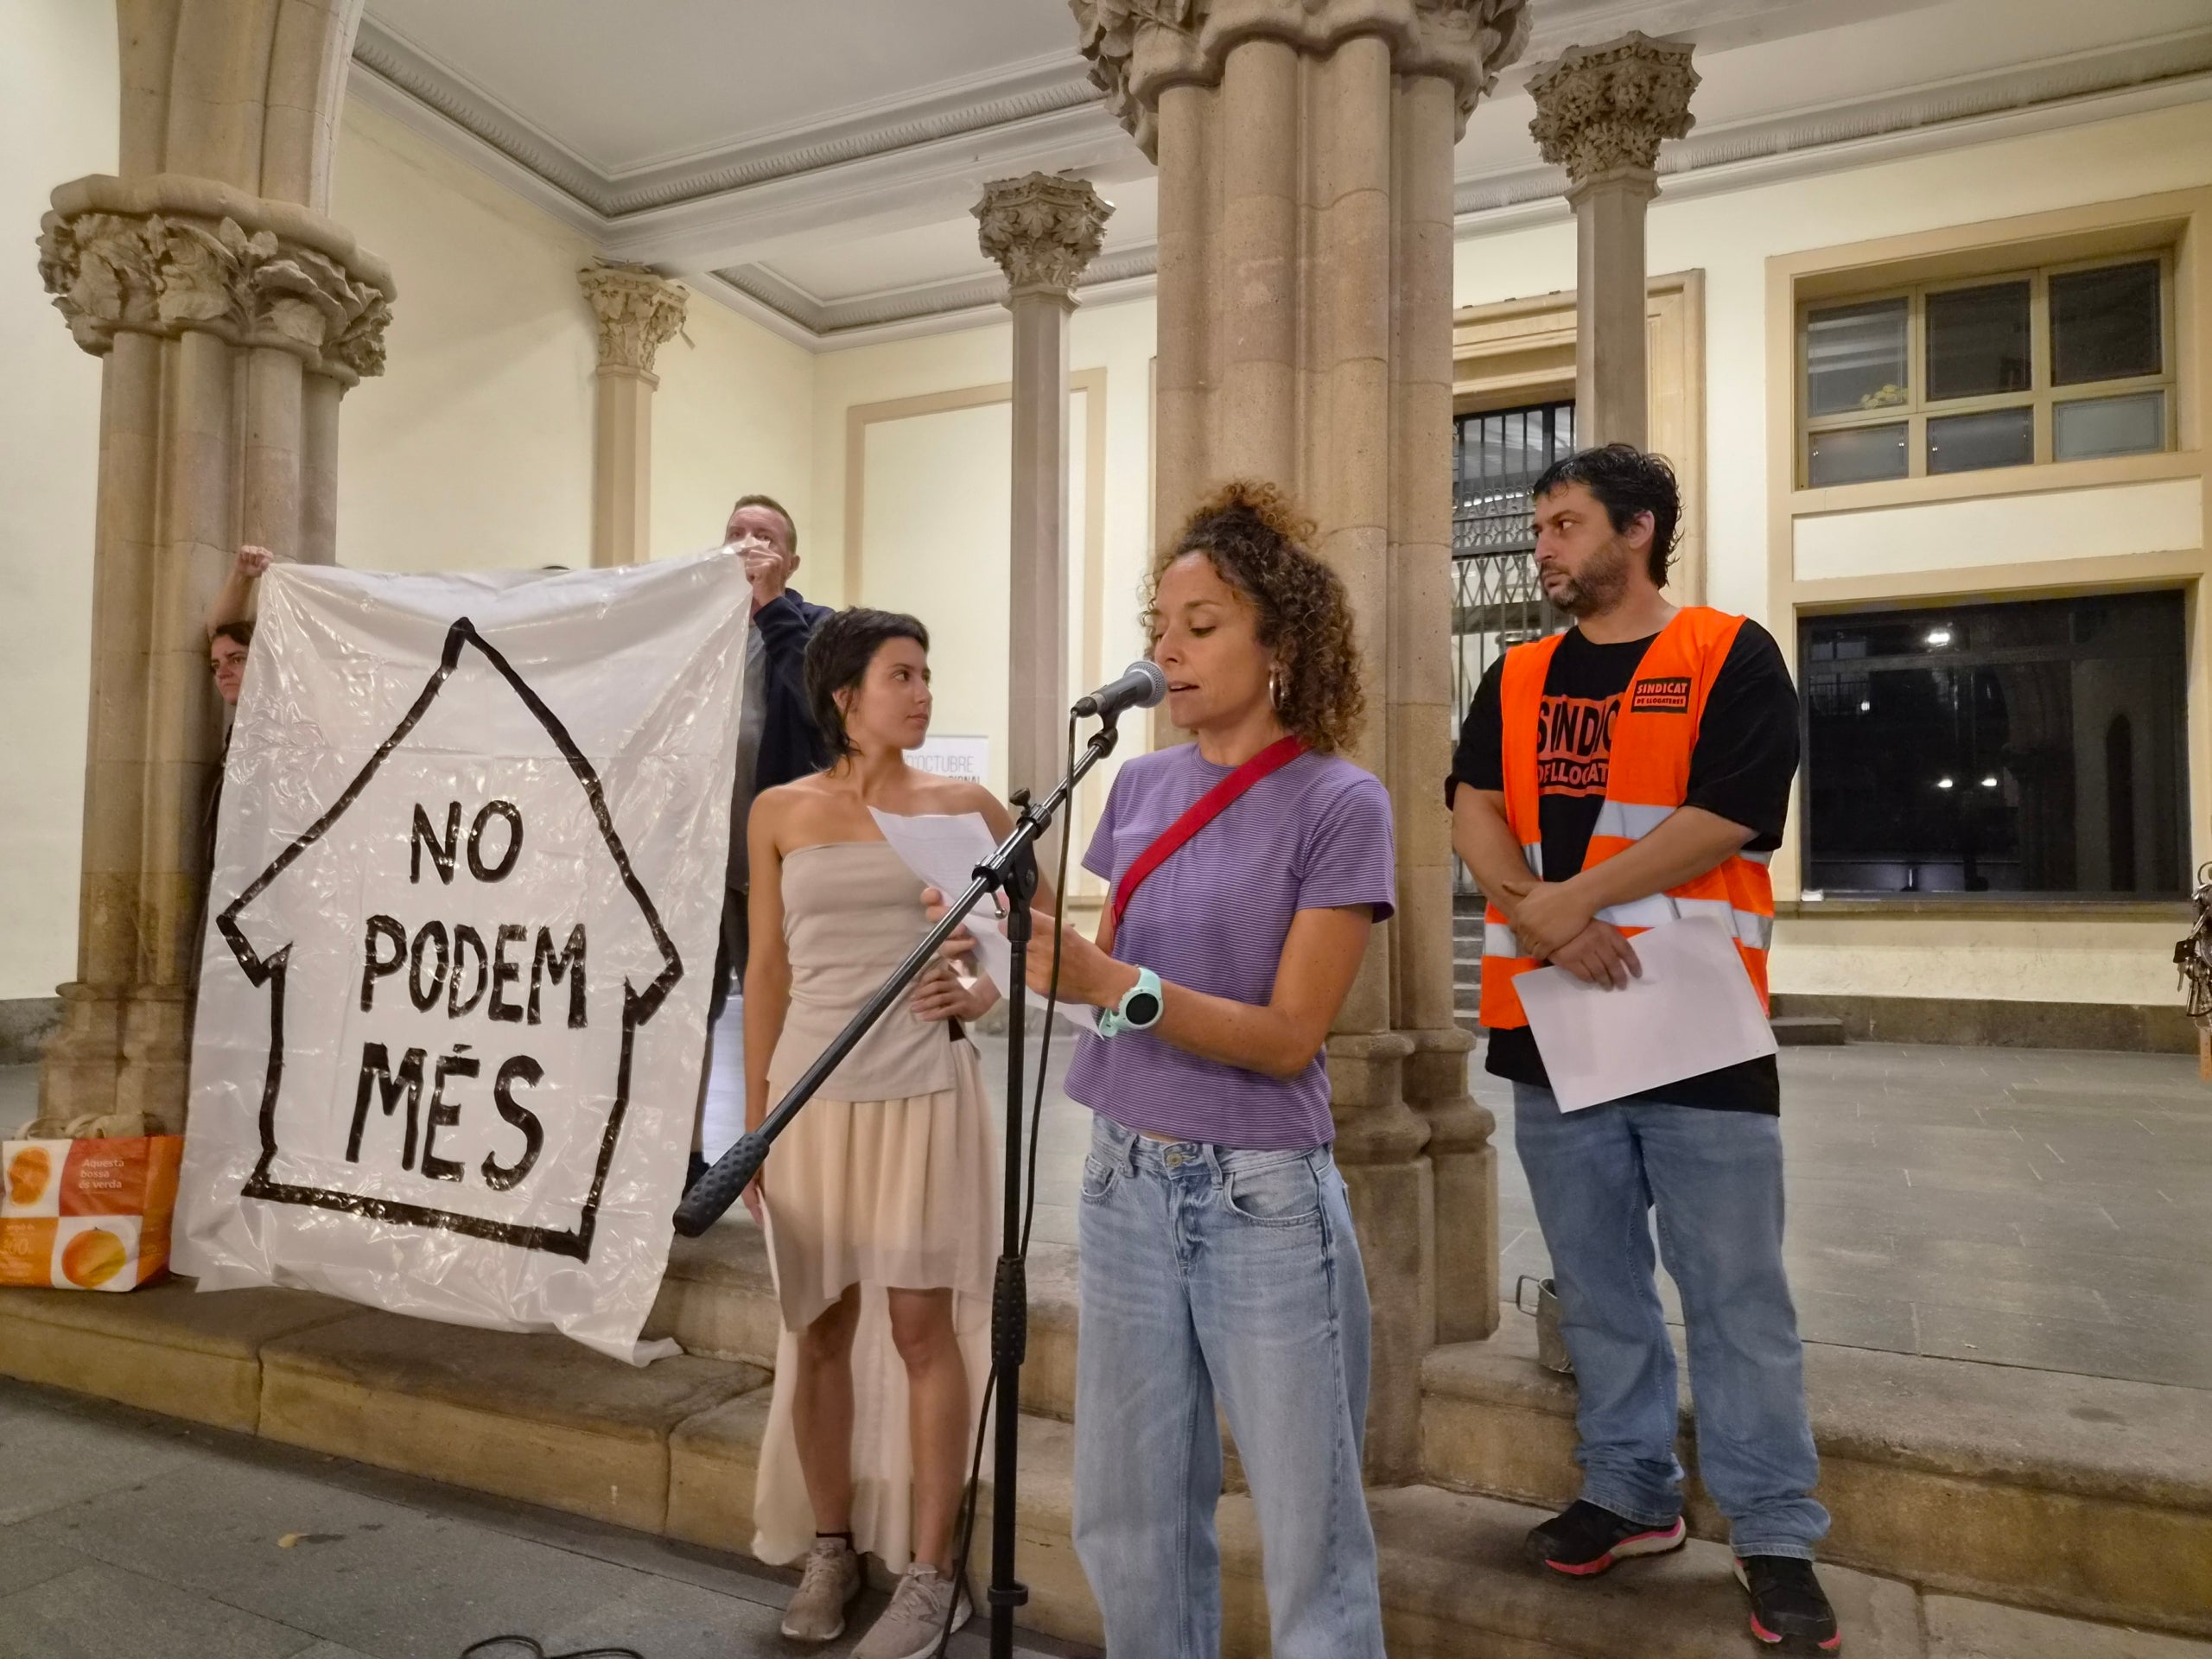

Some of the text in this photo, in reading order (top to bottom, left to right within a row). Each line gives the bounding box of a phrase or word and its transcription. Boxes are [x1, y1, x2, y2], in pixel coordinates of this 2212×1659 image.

[1637, 683, 1688, 694] SINDICAT
[410, 800, 524, 885] NO
[360, 914, 588, 1028] PODEM
[346, 1042, 545, 1191] MÉS
[79, 1179, 122, 1189] és verda
[82, 1159, 124, 1168] Aquesta
